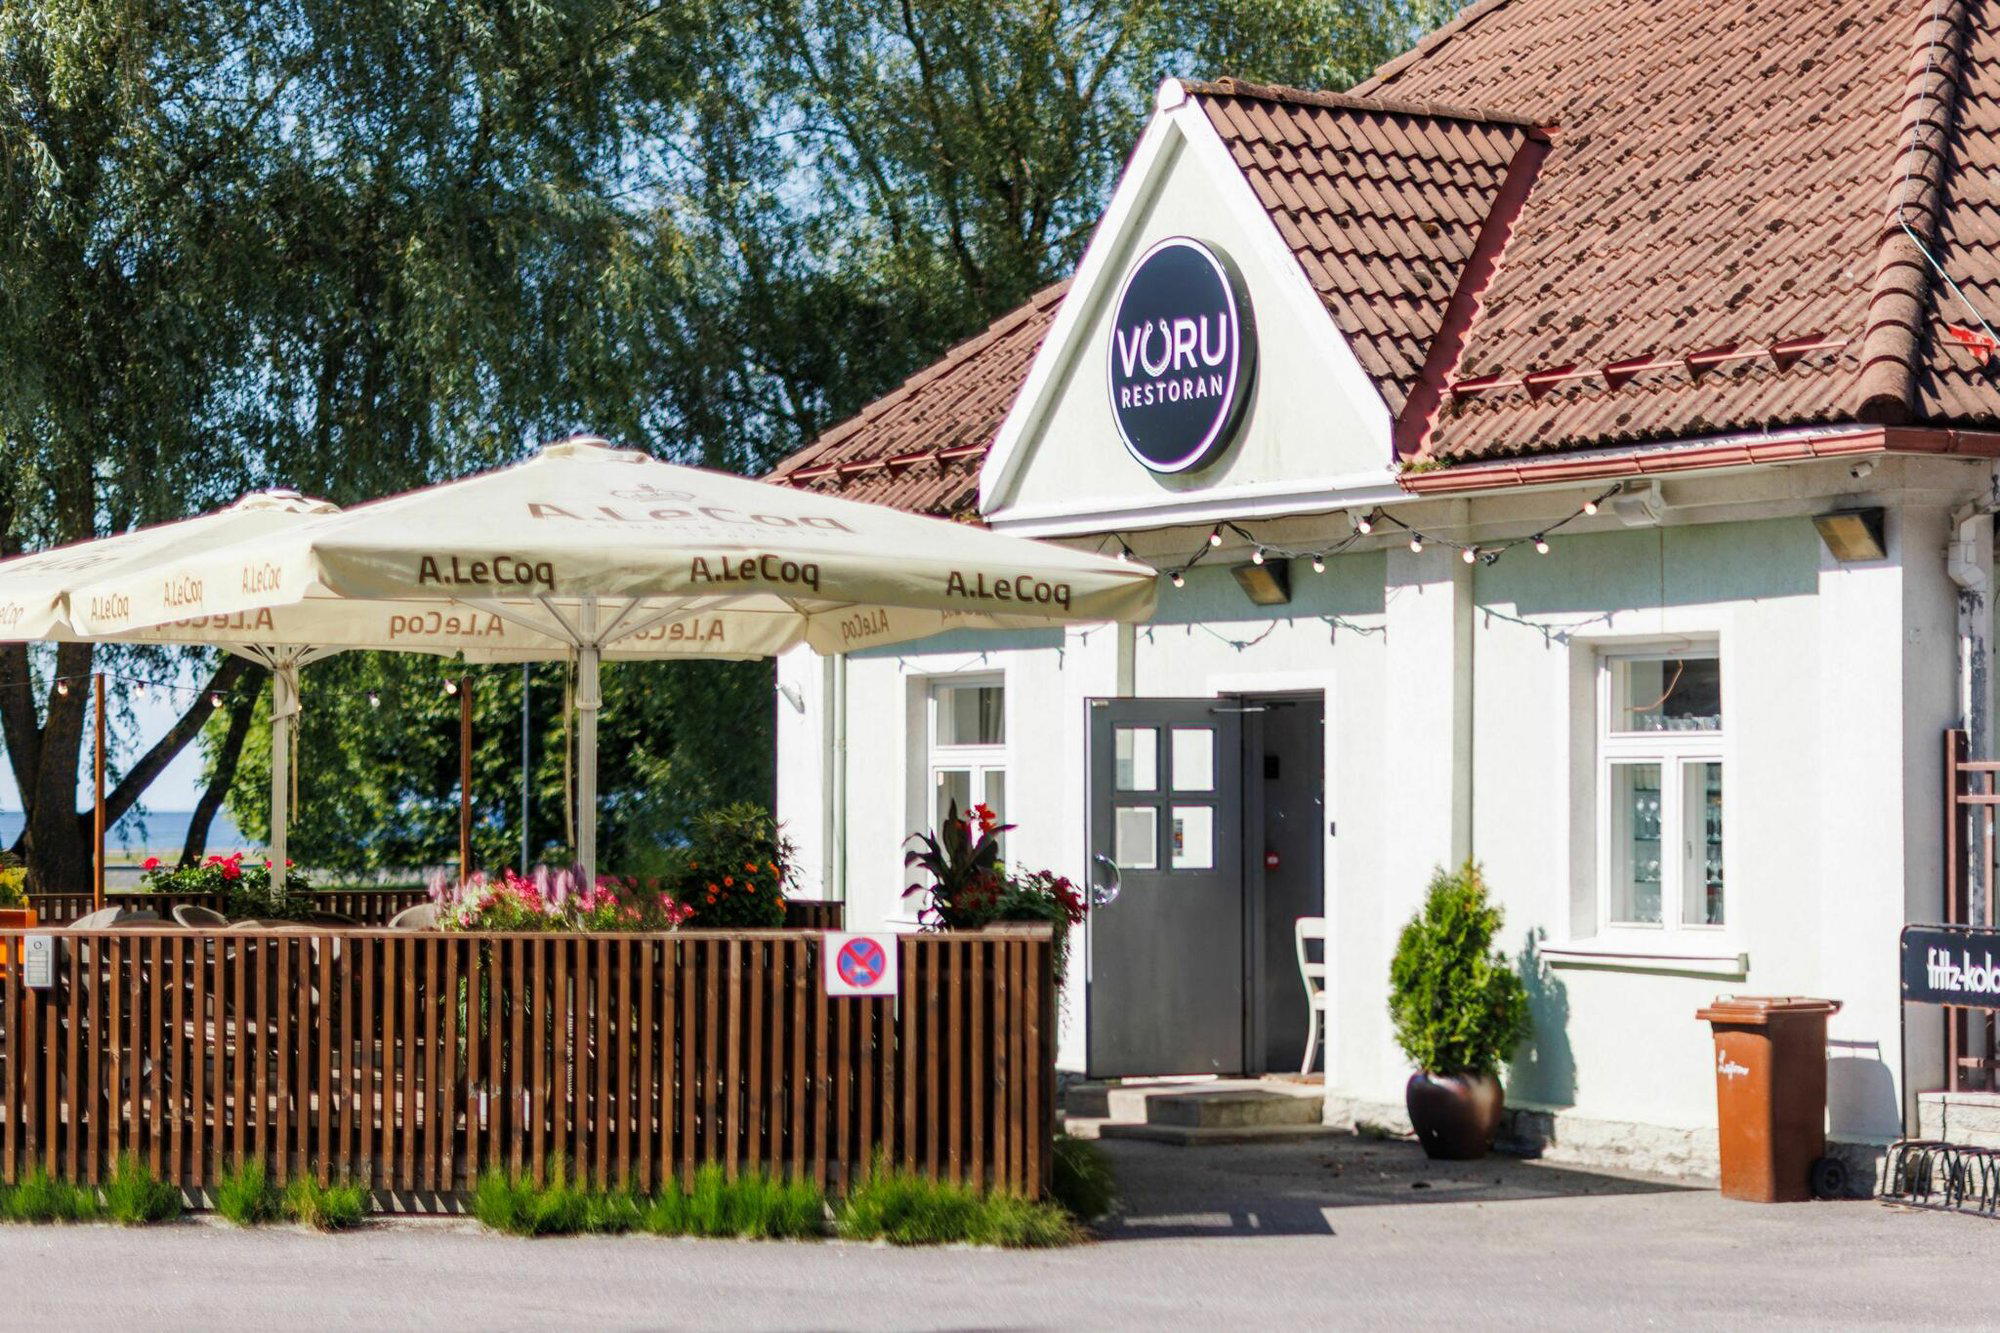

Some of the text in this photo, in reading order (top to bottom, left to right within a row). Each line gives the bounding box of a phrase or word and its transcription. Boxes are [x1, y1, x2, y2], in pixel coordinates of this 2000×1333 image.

[1121, 374, 1223, 409] RESTORAN
[419, 556, 555, 590] A.LeCoq
[690, 555, 820, 591] A.LeCoq
[163, 576, 203, 608] A.LeCoq
[946, 571, 1072, 610] A.LeCoq
[90, 593, 130, 624] A.LeCoq
